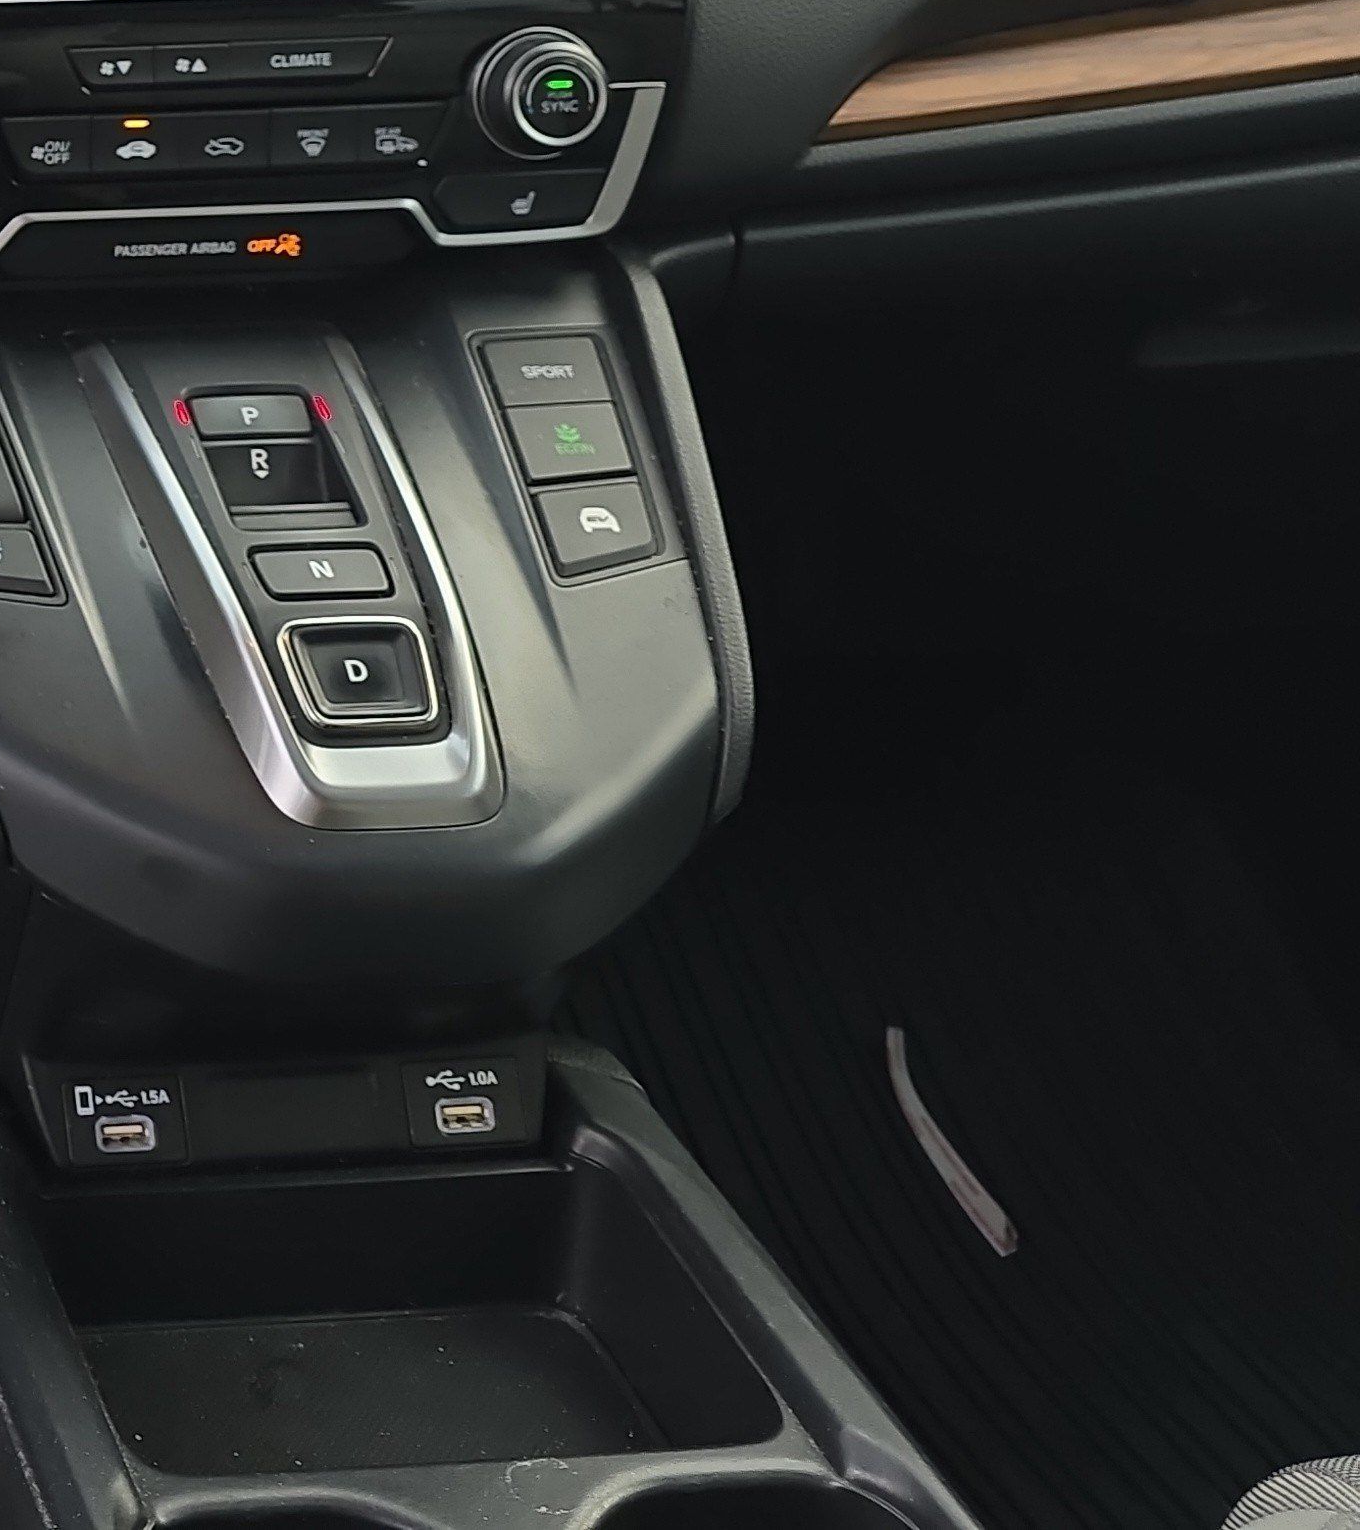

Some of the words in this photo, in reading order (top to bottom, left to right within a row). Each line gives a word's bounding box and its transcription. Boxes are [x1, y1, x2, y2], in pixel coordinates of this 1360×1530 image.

[270, 53, 332, 69] CLIMATE
[540, 99, 579, 113] SYNC
[43, 152, 70, 165] OFF
[114, 242, 188, 258] PASSENGER
[189, 240, 238, 255] AIRBAG
[247, 238, 278, 254] OFF
[520, 364, 575, 380] SPORT
[240, 406, 260, 426] P
[250, 448, 270, 470] R
[309, 559, 336, 579] N
[343, 658, 370, 683] D
